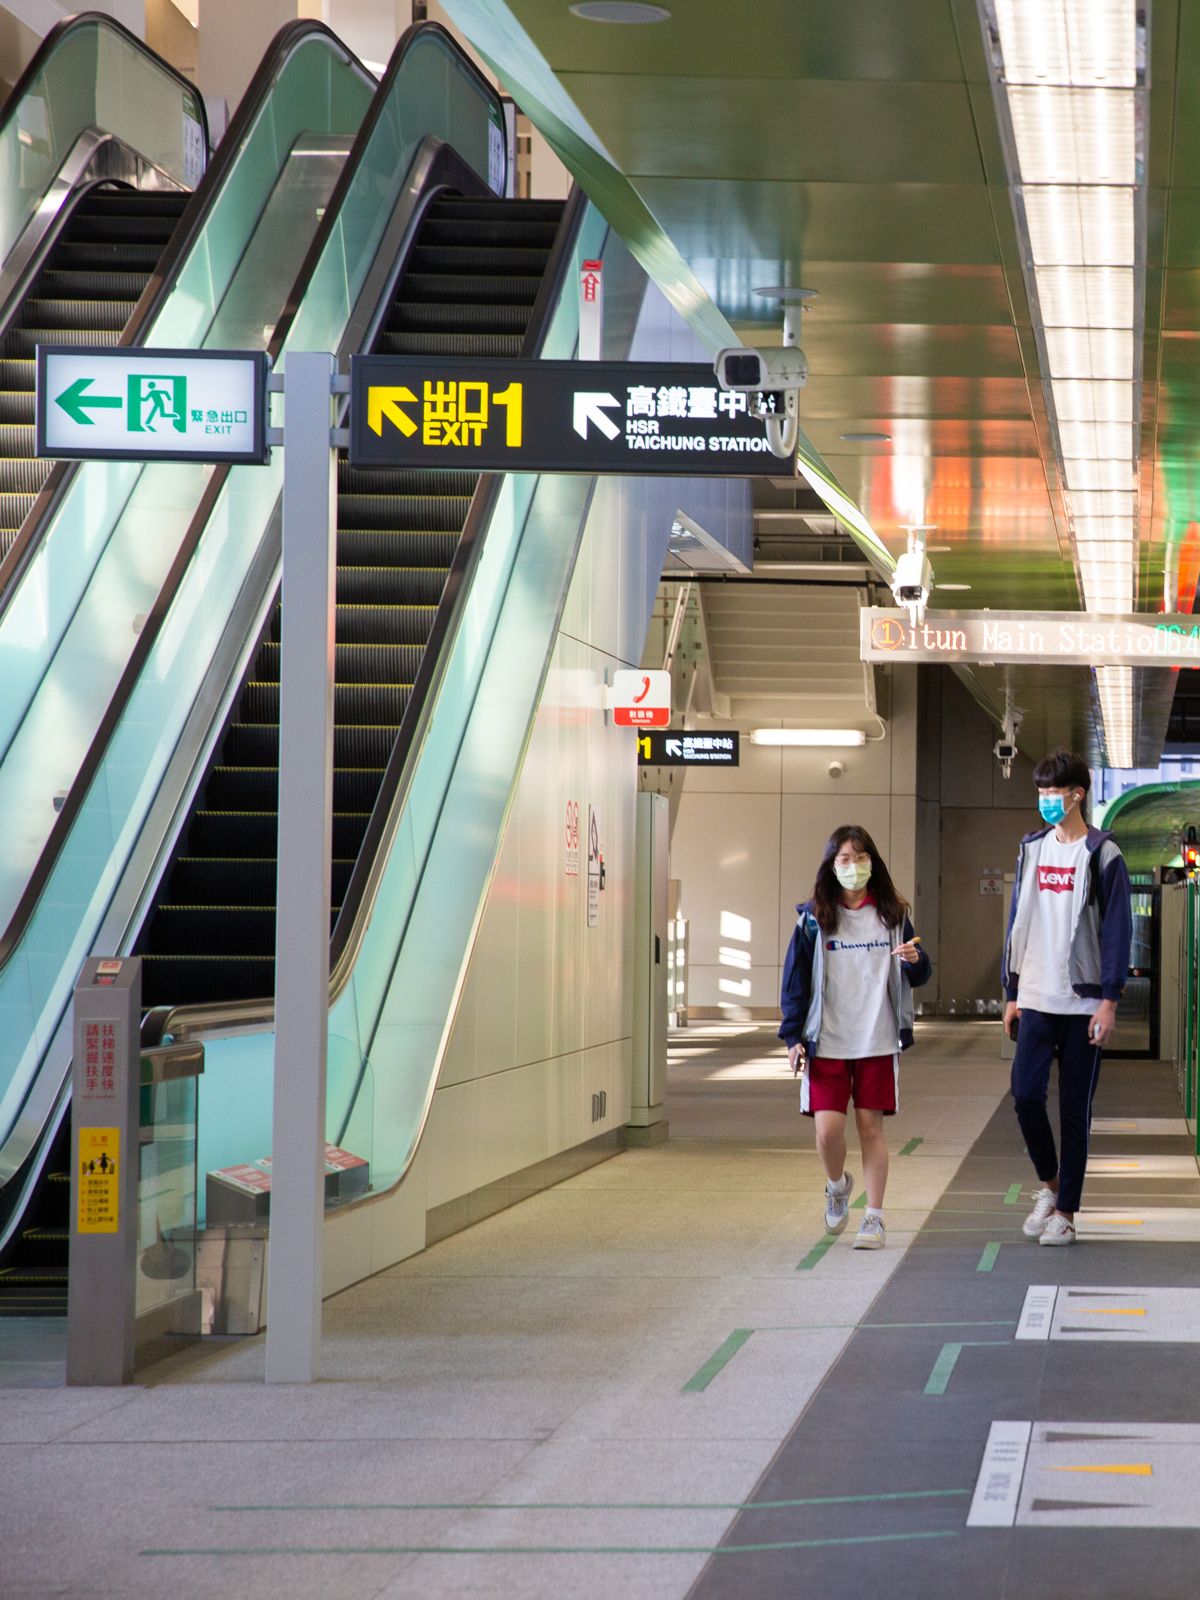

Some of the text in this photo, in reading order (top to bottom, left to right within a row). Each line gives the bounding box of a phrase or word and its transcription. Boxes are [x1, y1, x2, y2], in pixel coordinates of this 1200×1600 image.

[191, 409, 247, 423] 緊急出口
[424, 381, 522, 448] 出口 1
[205, 425, 232, 434] EXIT
[423, 421, 488, 446] EXIT
[626, 420, 660, 434] HSR
[626, 435, 773, 452] TAICHUNG STATION
[903, 623, 967, 650] itun
[982, 622, 1044, 650] Main
[640, 736, 652, 759] 1
